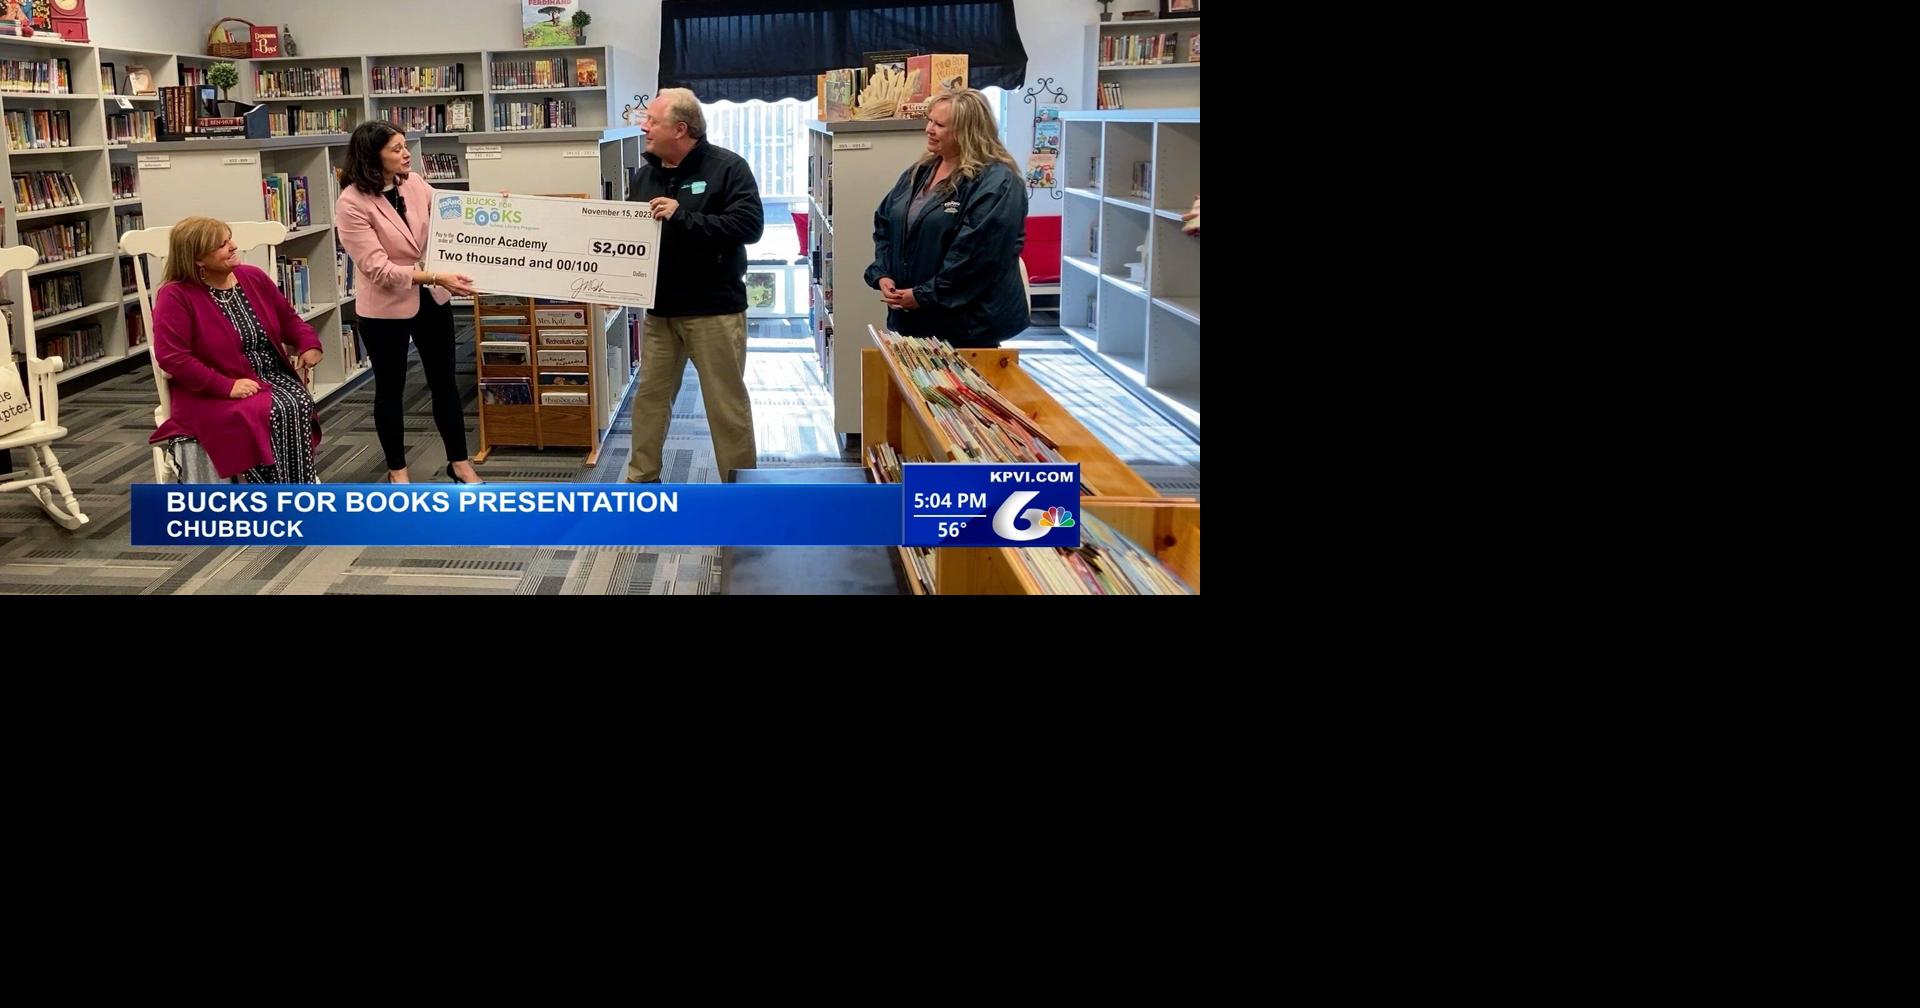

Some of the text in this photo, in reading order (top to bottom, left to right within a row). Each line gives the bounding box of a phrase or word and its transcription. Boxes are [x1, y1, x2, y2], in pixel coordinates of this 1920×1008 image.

[466, 197, 497, 206] BUCKS
[465, 207, 522, 226] BOOKS
[582, 208, 652, 219] November 15, 2023
[456, 233, 548, 252] Connor Academy
[592, 241, 646, 257] $2,000
[438, 249, 598, 273] Two thousand and 00/100
[0, 402, 28, 423] pter
